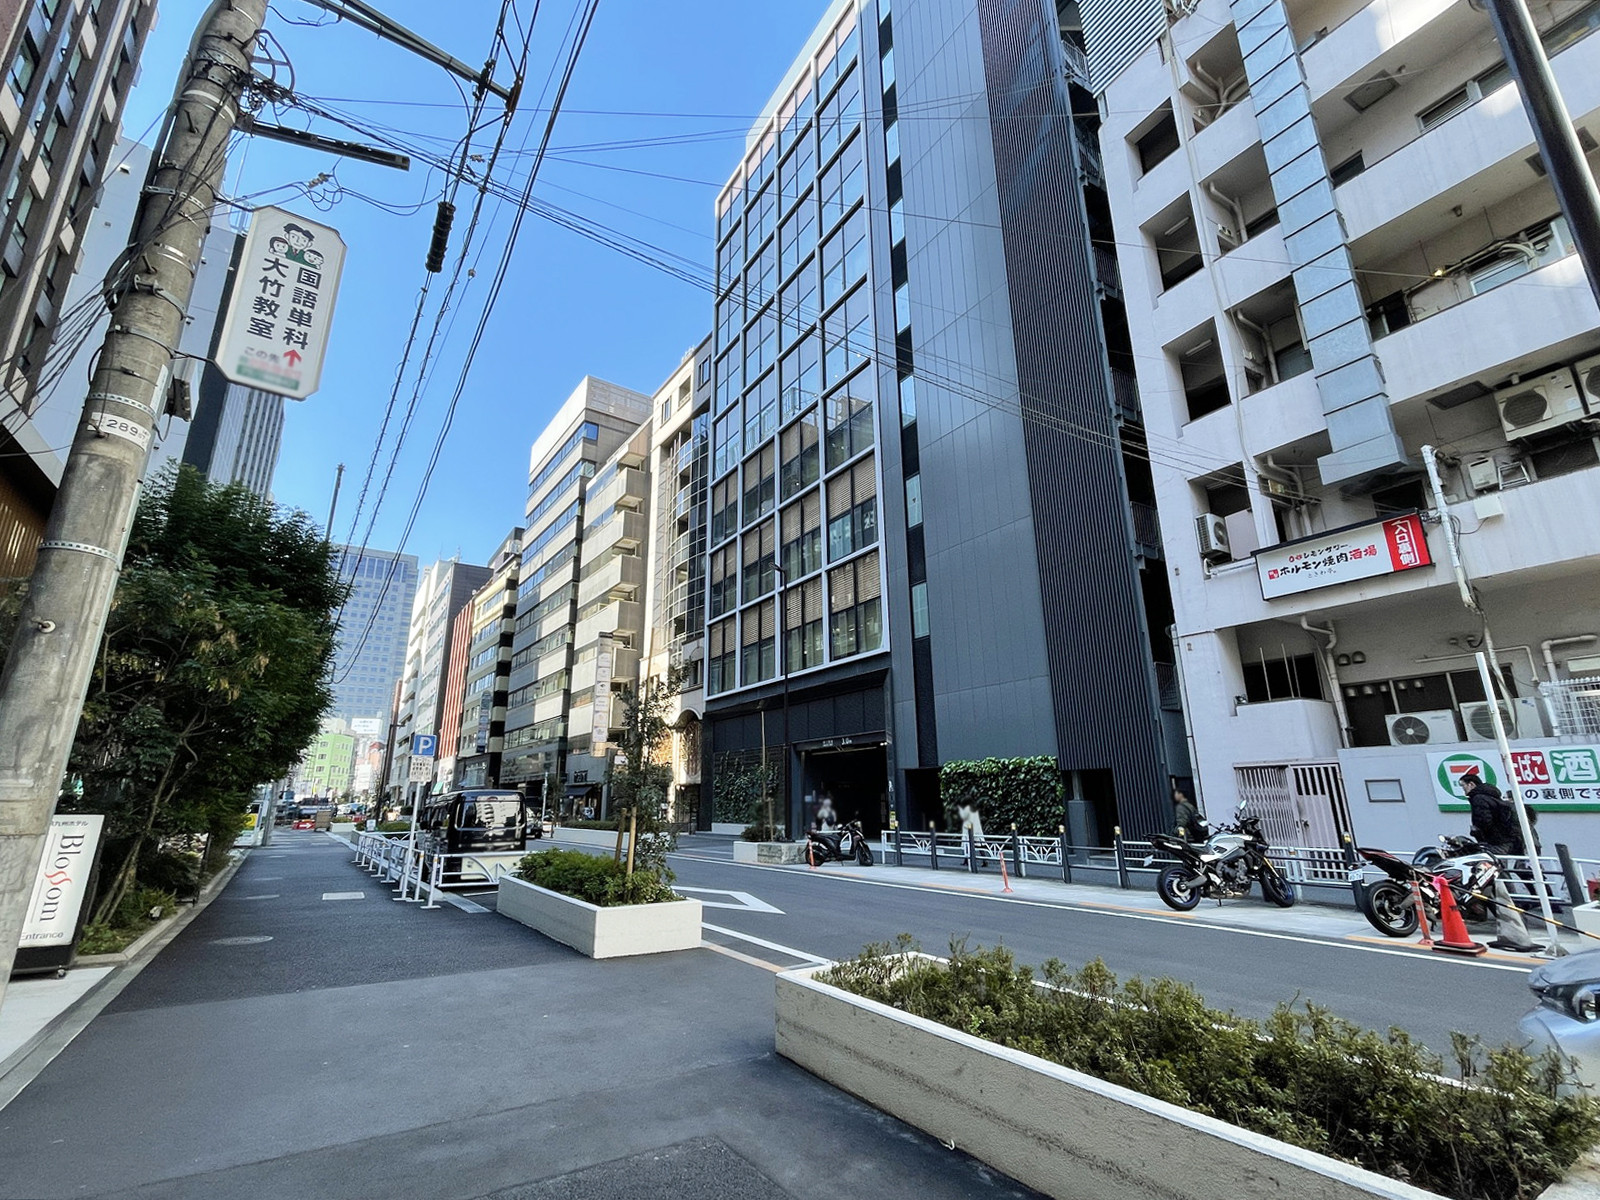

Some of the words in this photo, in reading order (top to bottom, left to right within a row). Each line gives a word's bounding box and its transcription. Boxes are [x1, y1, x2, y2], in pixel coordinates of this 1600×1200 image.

[247, 257, 289, 340] 大竹教室
[283, 267, 322, 350] 国語単科
[244, 346, 280, 363] この先
[106, 419, 138, 436] 289
[1279, 544, 1378, 577] ホルモン焼肉酒場
[418, 736, 432, 754] P
[1551, 751, 1599, 782] 酒
[1521, 787, 1600, 800] の裏側です
[39, 833, 85, 922] Blossom
